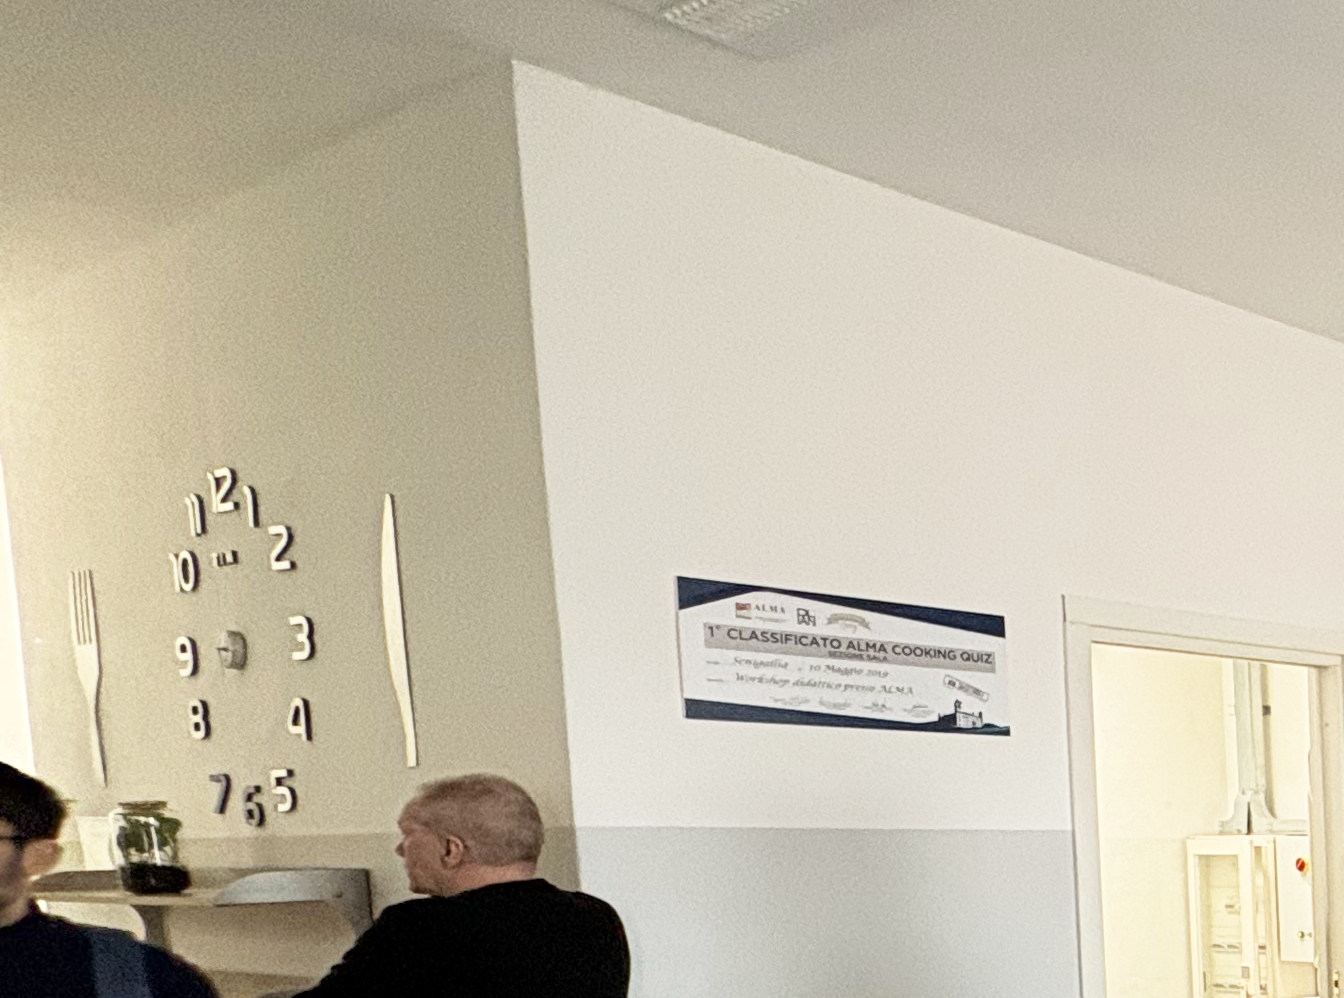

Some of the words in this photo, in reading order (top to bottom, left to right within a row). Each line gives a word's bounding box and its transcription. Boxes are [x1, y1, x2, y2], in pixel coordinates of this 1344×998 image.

[207, 467, 238, 513] 12
[242, 485, 259, 528] 1
[185, 493, 205, 537] 11
[268, 525, 294, 571] 2
[169, 550, 197, 592] 10
[175, 636, 198, 677] 9
[289, 615, 314, 661] 3
[726, 628, 843, 650] CLASSIFICATO
[846, 639, 888, 655] ALMA
[891, 644, 958, 662] COOKING
[959, 651, 994, 665] QUIZ
[188, 699, 211, 740] 8
[287, 697, 313, 742] 4
[209, 773, 231, 814] 7
[244, 784, 265, 826] 6
[270, 768, 297, 813] 5
